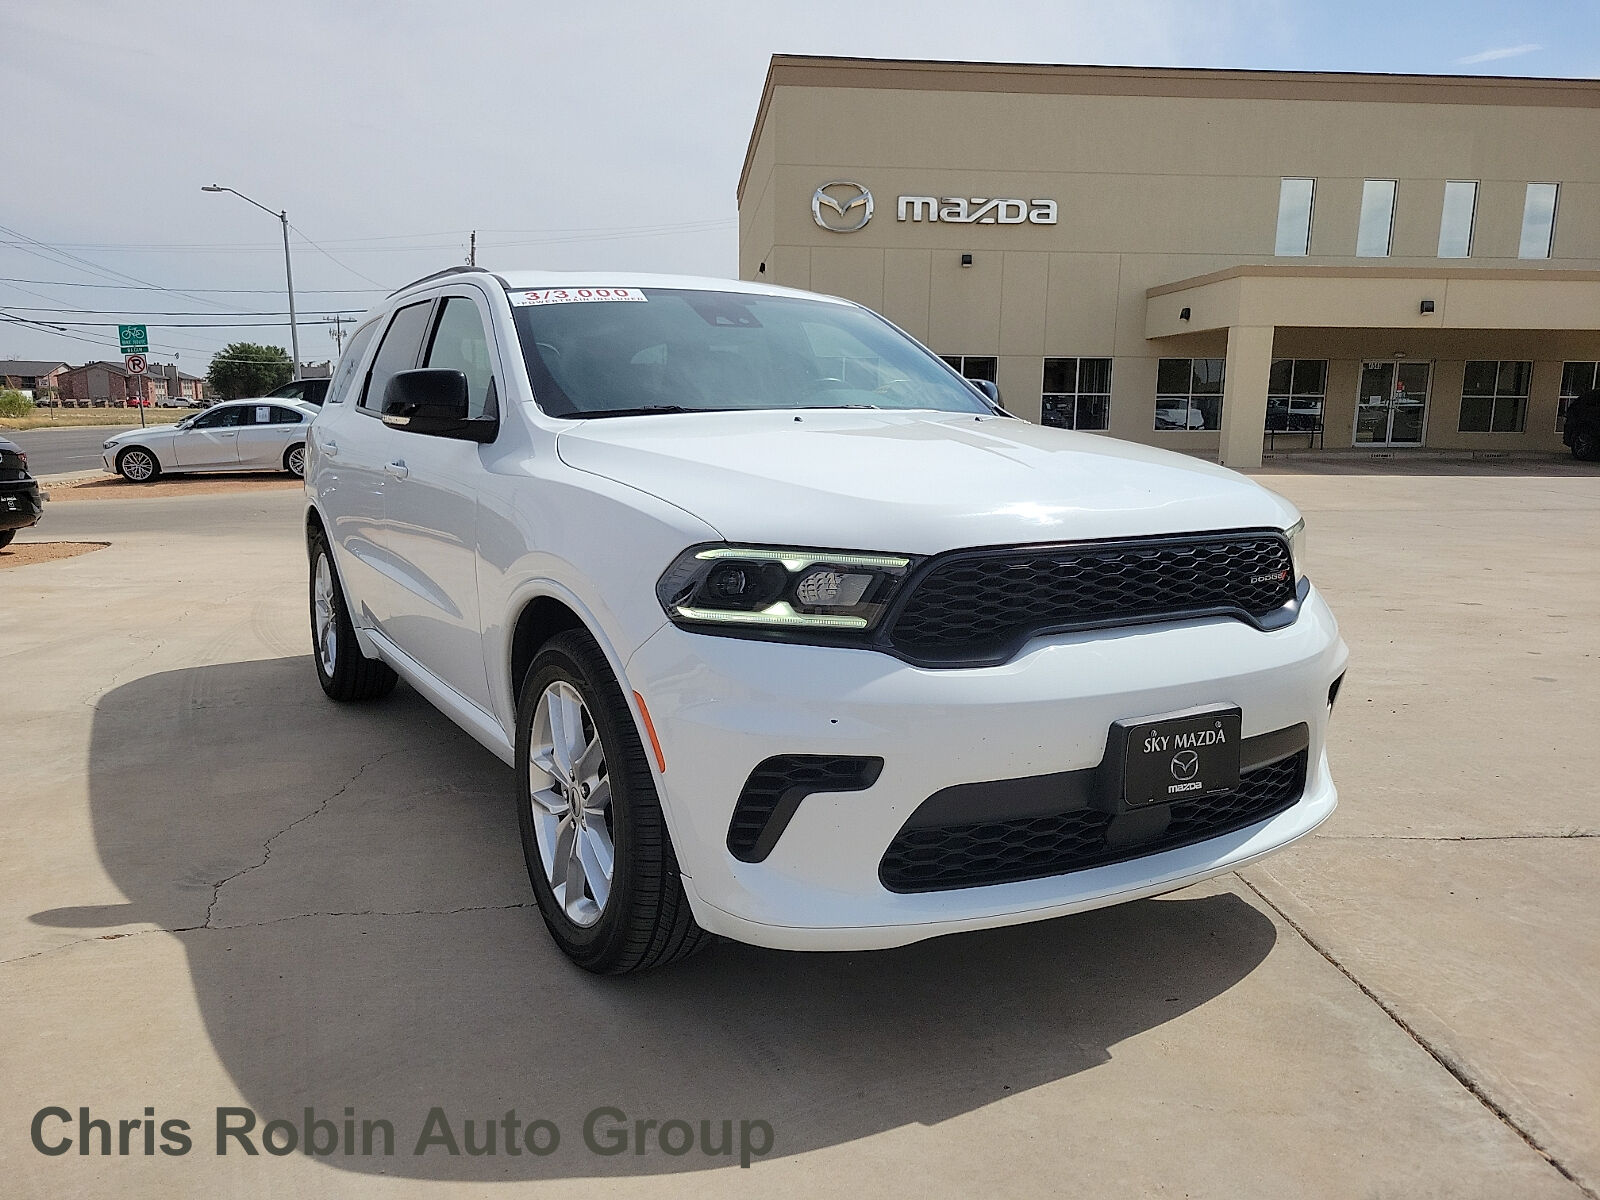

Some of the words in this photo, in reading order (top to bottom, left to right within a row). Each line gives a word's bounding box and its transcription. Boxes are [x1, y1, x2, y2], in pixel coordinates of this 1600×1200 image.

[897, 195, 1058, 224] mazda
[1250, 573, 1284, 584] DODGE
[1143, 735, 1170, 754] SKY
[1174, 729, 1226, 749] MAZDA
[1168, 781, 1203, 794] mazda
